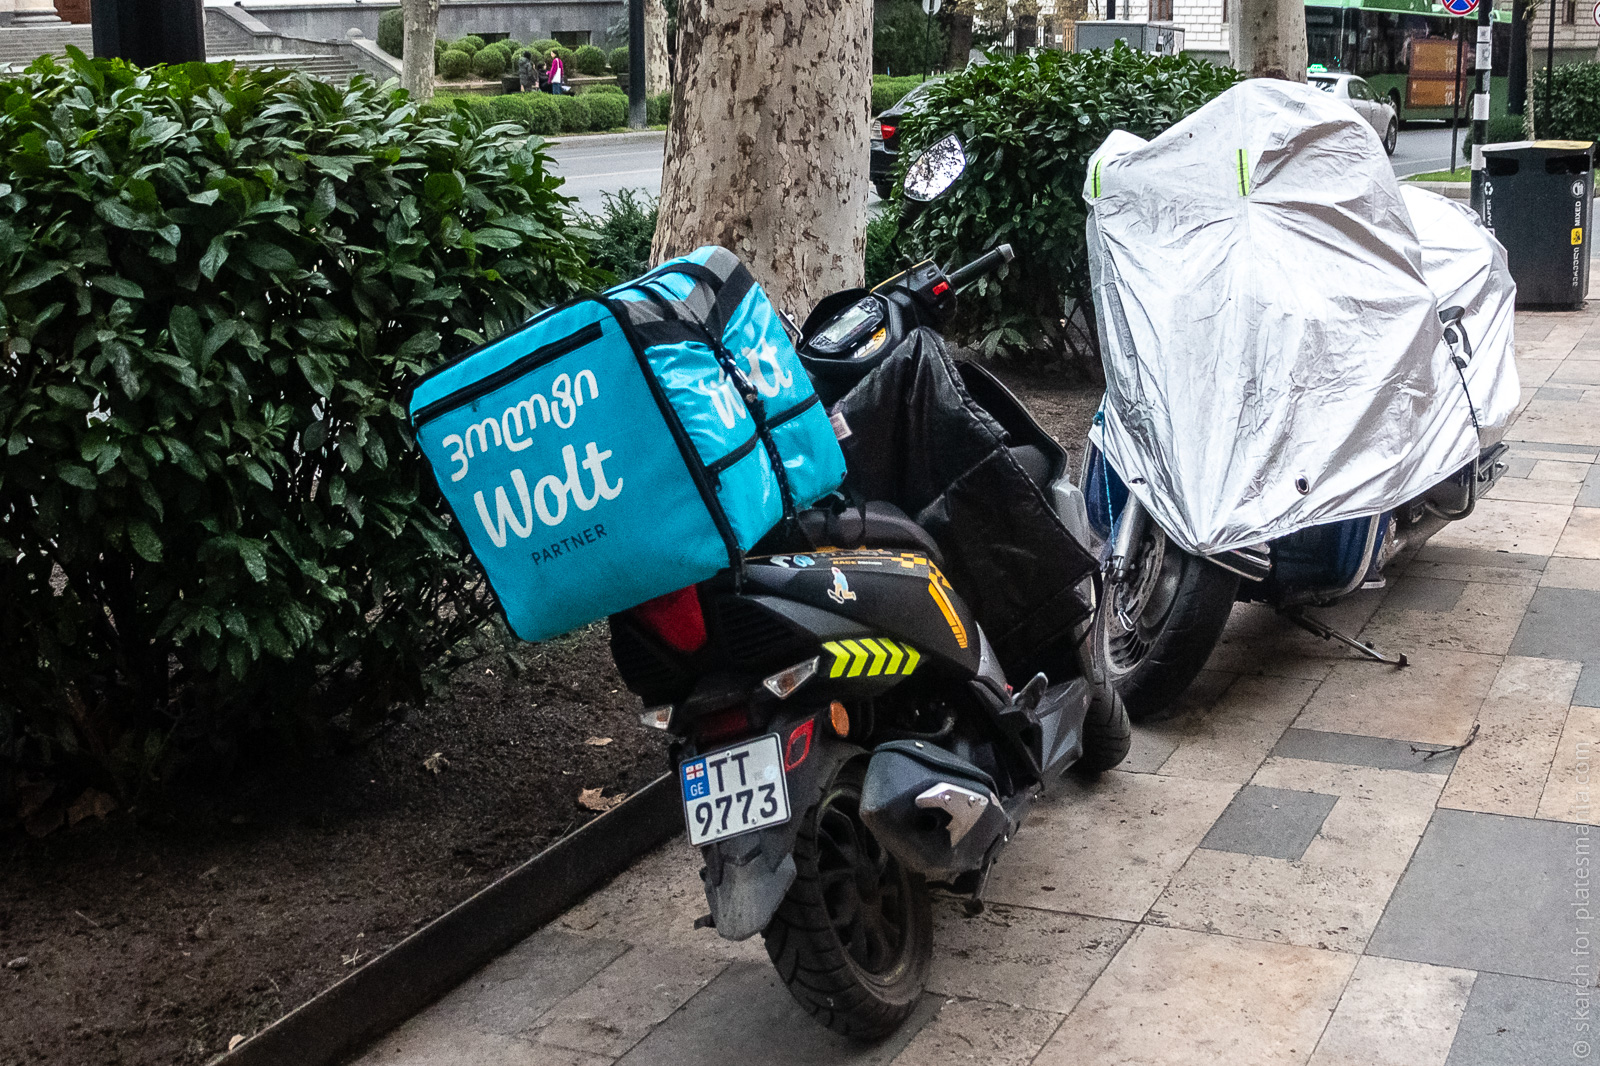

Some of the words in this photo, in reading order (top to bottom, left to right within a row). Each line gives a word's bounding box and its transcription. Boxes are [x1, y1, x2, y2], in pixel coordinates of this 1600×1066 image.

[1574, 200, 1582, 226] MIXED
[698, 337, 793, 429] Wlt
[442, 369, 600, 482] ვოლტი
[474, 442, 624, 548] Wolt
[531, 523, 608, 566] PARTNER
[690, 782, 705, 797] GE
[709, 751, 750, 793] TT
[695, 782, 778, 837] 9773
